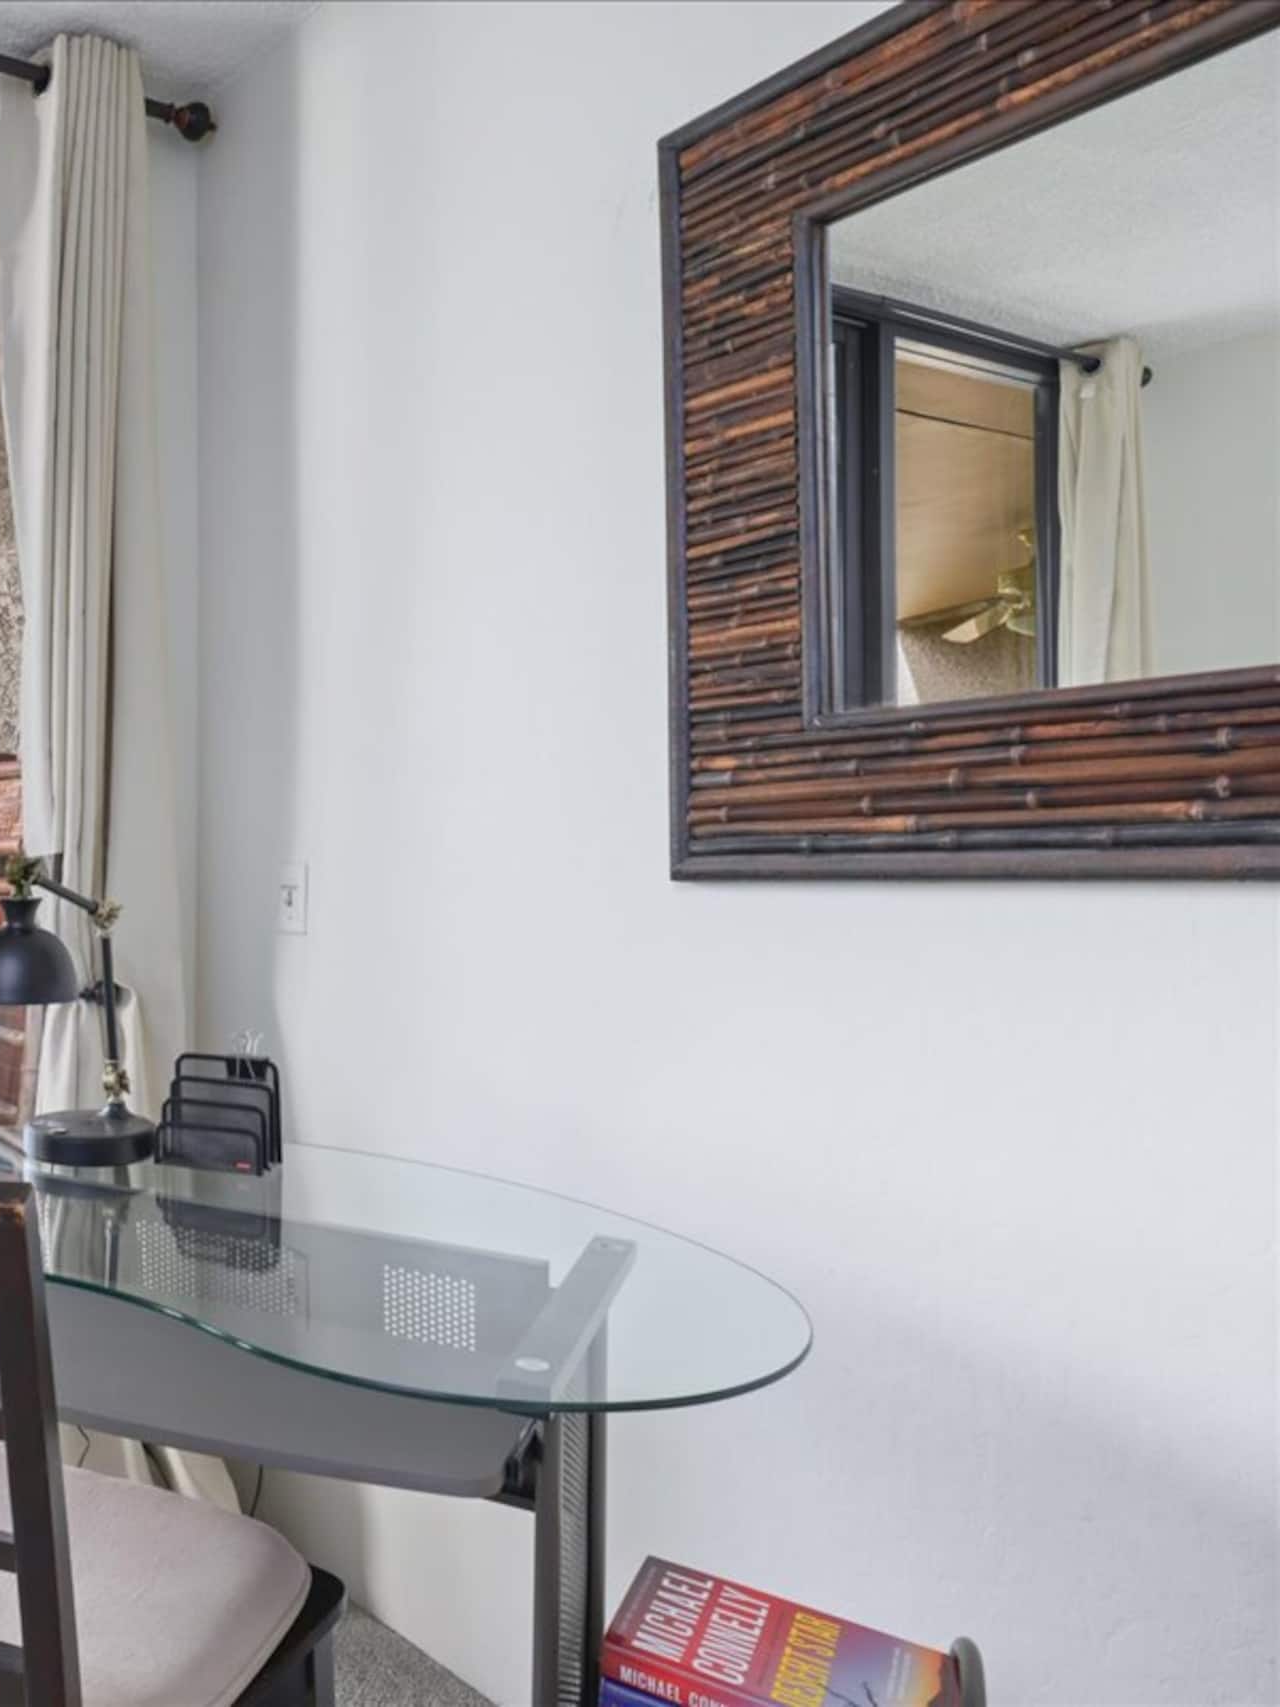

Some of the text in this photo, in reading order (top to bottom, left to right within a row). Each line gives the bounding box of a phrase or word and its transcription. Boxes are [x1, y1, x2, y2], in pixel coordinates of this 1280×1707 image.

[632, 1571, 713, 1661] MICHAEL
[692, 1587, 771, 1685] CONNELLY
[770, 1611, 842, 1707] DESERT STAR
[619, 1664, 682, 1704] MICHAEL
